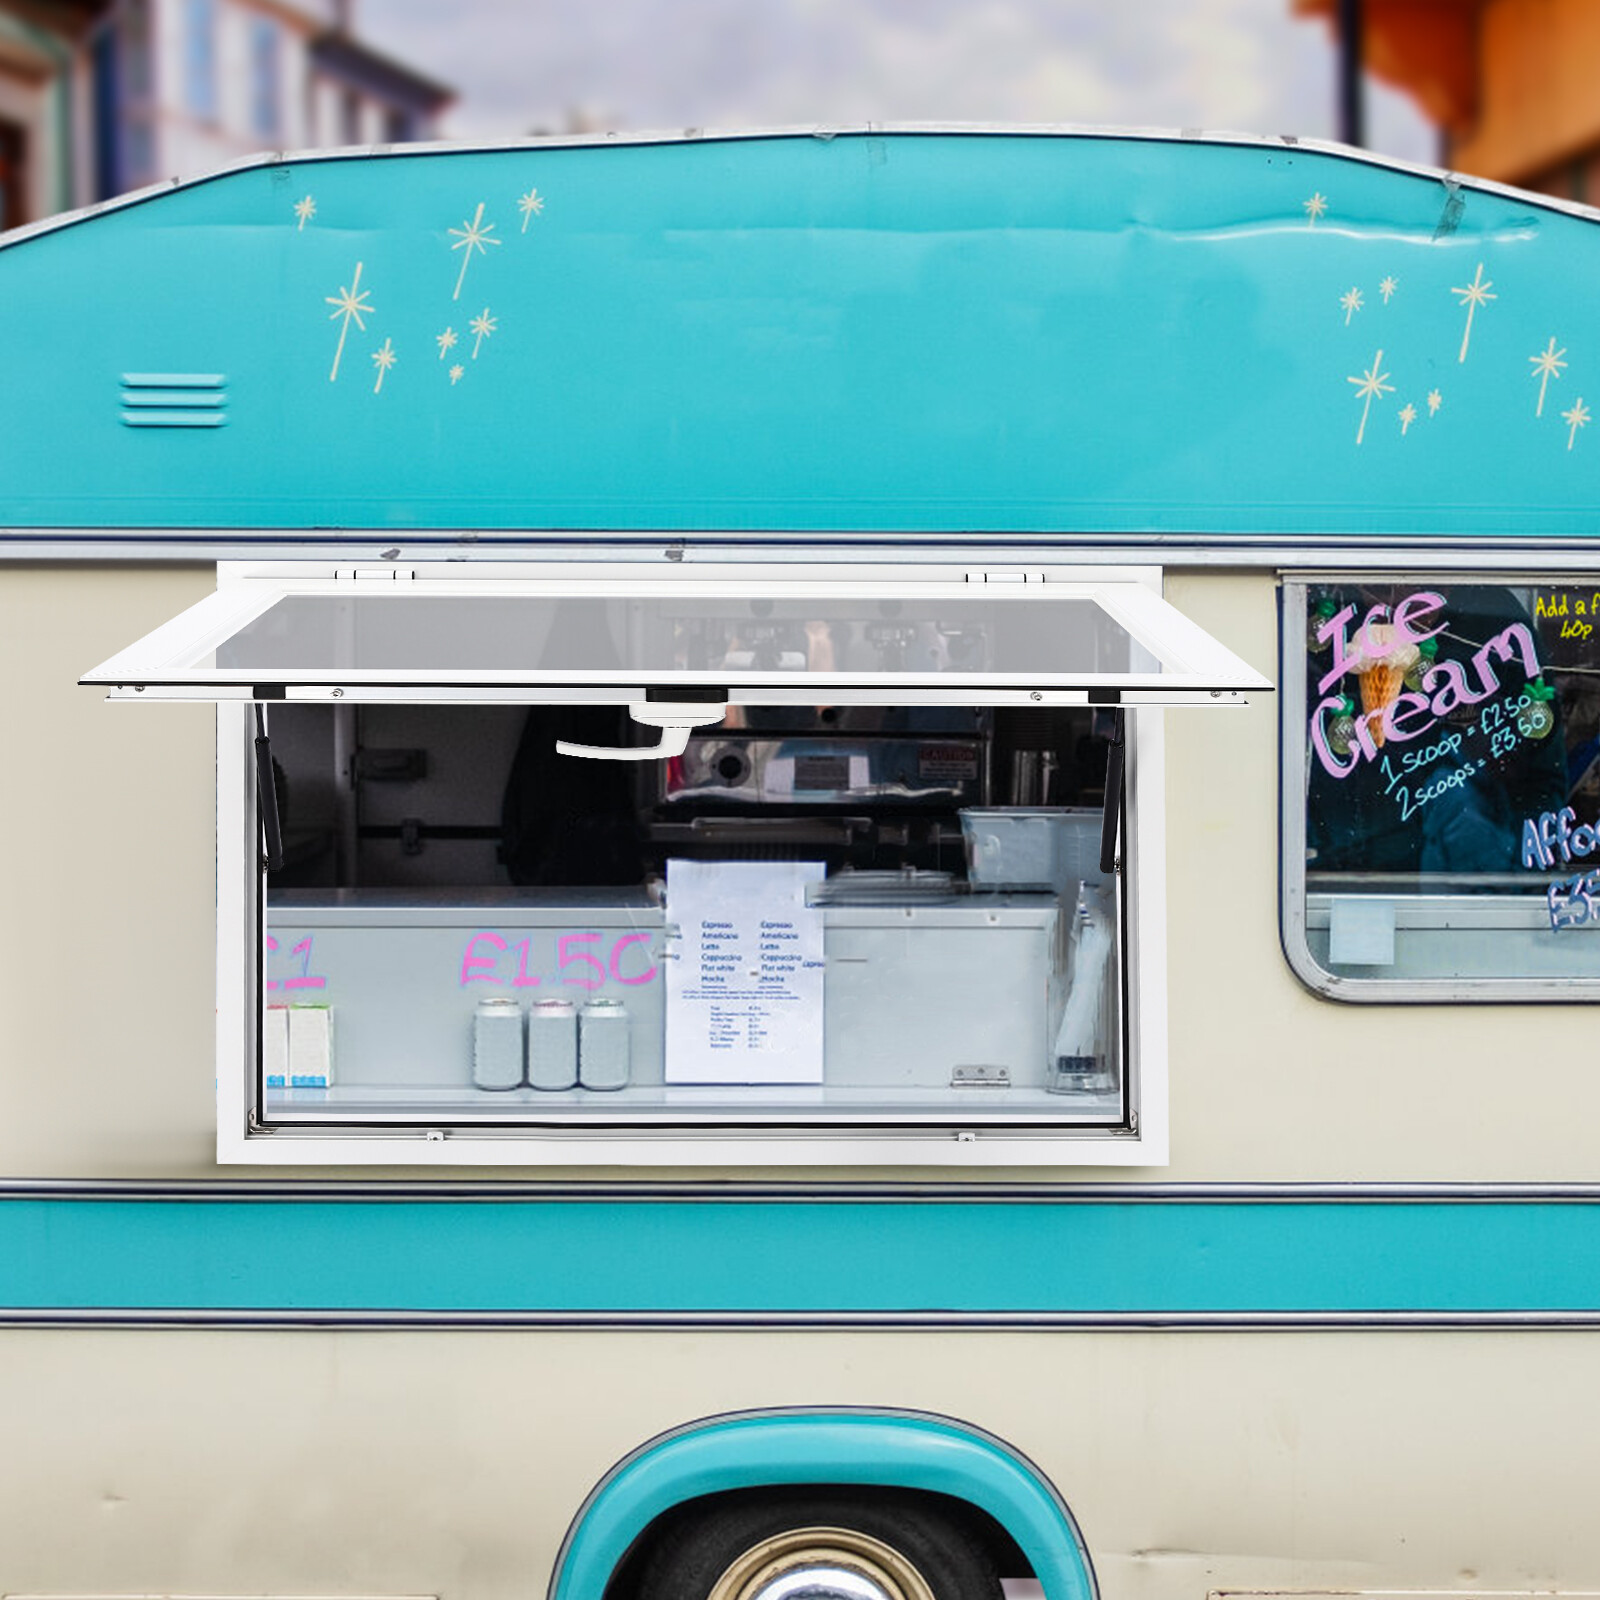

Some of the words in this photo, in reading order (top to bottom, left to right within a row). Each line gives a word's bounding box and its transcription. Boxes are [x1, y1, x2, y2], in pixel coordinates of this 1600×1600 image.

[1536, 593, 1569, 618] Add
[1575, 600, 1587, 615] a
[1560, 619, 1593, 640] 40p
[1316, 590, 1449, 696] Ice
[1311, 622, 1541, 779] Cream
[1380, 755, 1403, 795] 1
[1402, 732, 1463, 774] scoop
[1480, 694, 1532, 735] £2.50
[1489, 712, 1546, 759] £3.50
[1521, 806, 1600, 871] Affo
